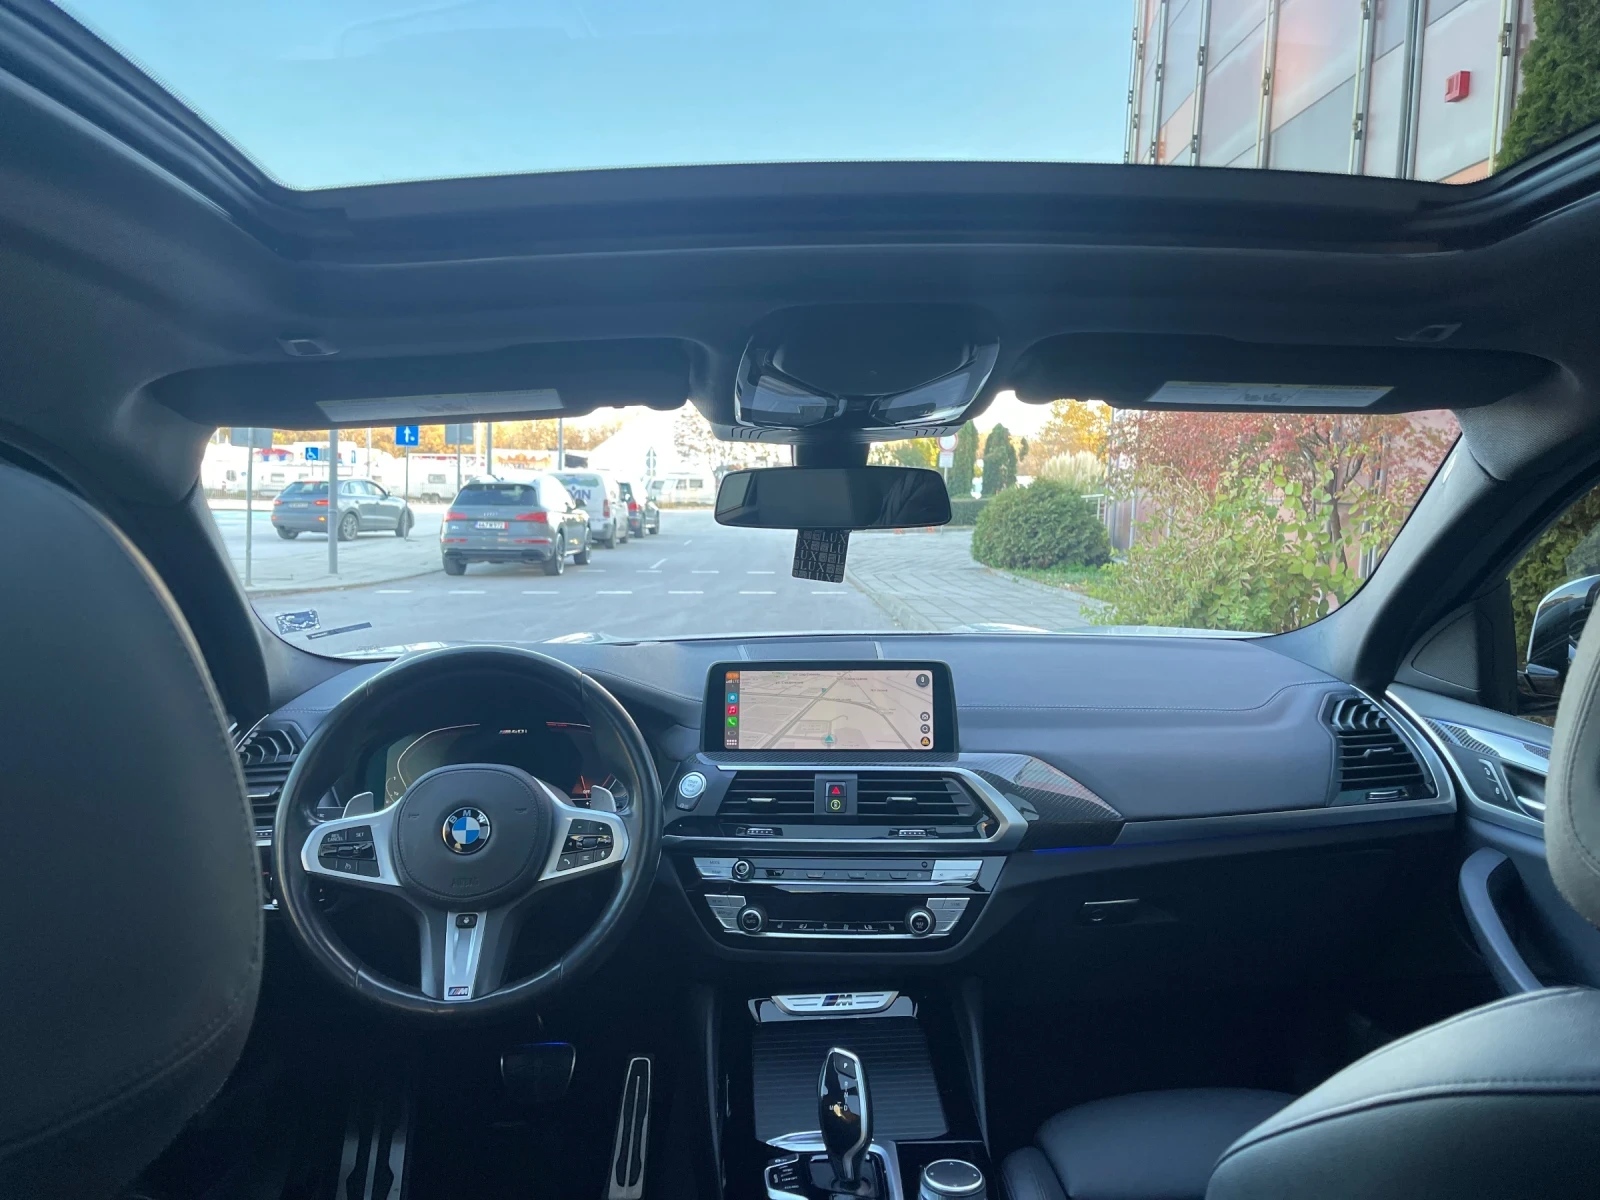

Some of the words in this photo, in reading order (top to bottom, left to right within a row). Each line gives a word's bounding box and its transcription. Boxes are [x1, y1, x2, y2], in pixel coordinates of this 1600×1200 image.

[822, 532, 848, 544] LUX
[800, 560, 826, 572] LUX
[449, 810, 486, 824] BMW
